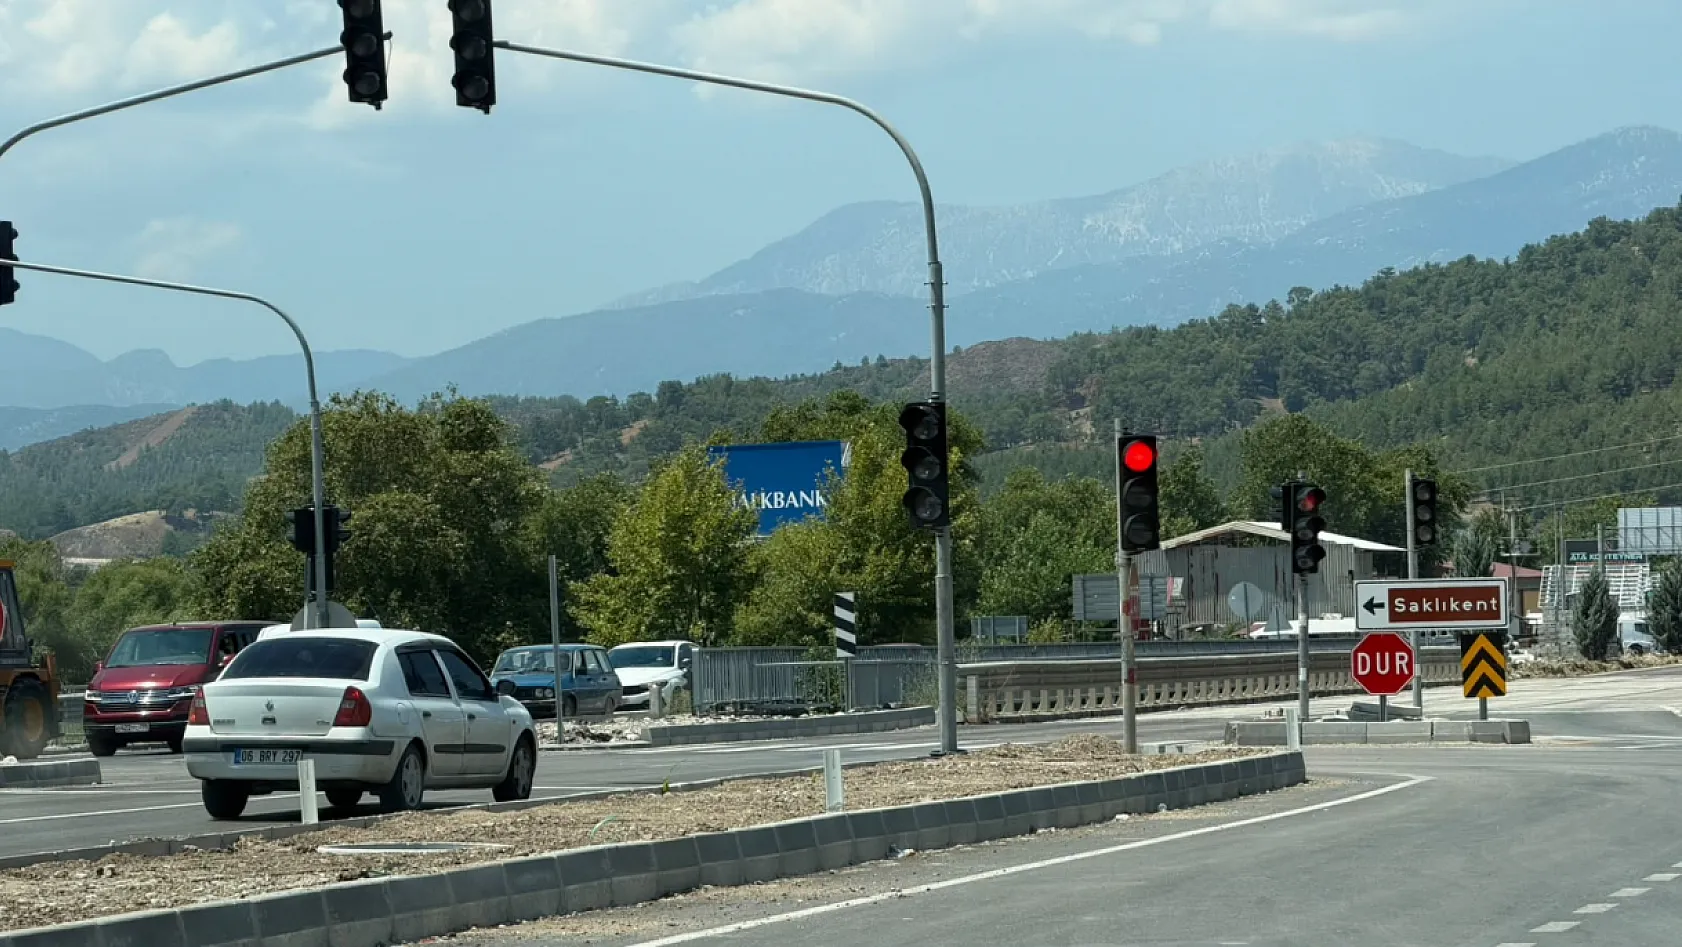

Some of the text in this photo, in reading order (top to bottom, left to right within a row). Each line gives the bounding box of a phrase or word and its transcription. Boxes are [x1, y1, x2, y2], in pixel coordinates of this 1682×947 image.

[1394, 597, 1498, 613] Saklıkent
[1356, 652, 1410, 676] DUR
[241, 750, 254, 763] 06
[281, 750, 301, 763] 297
